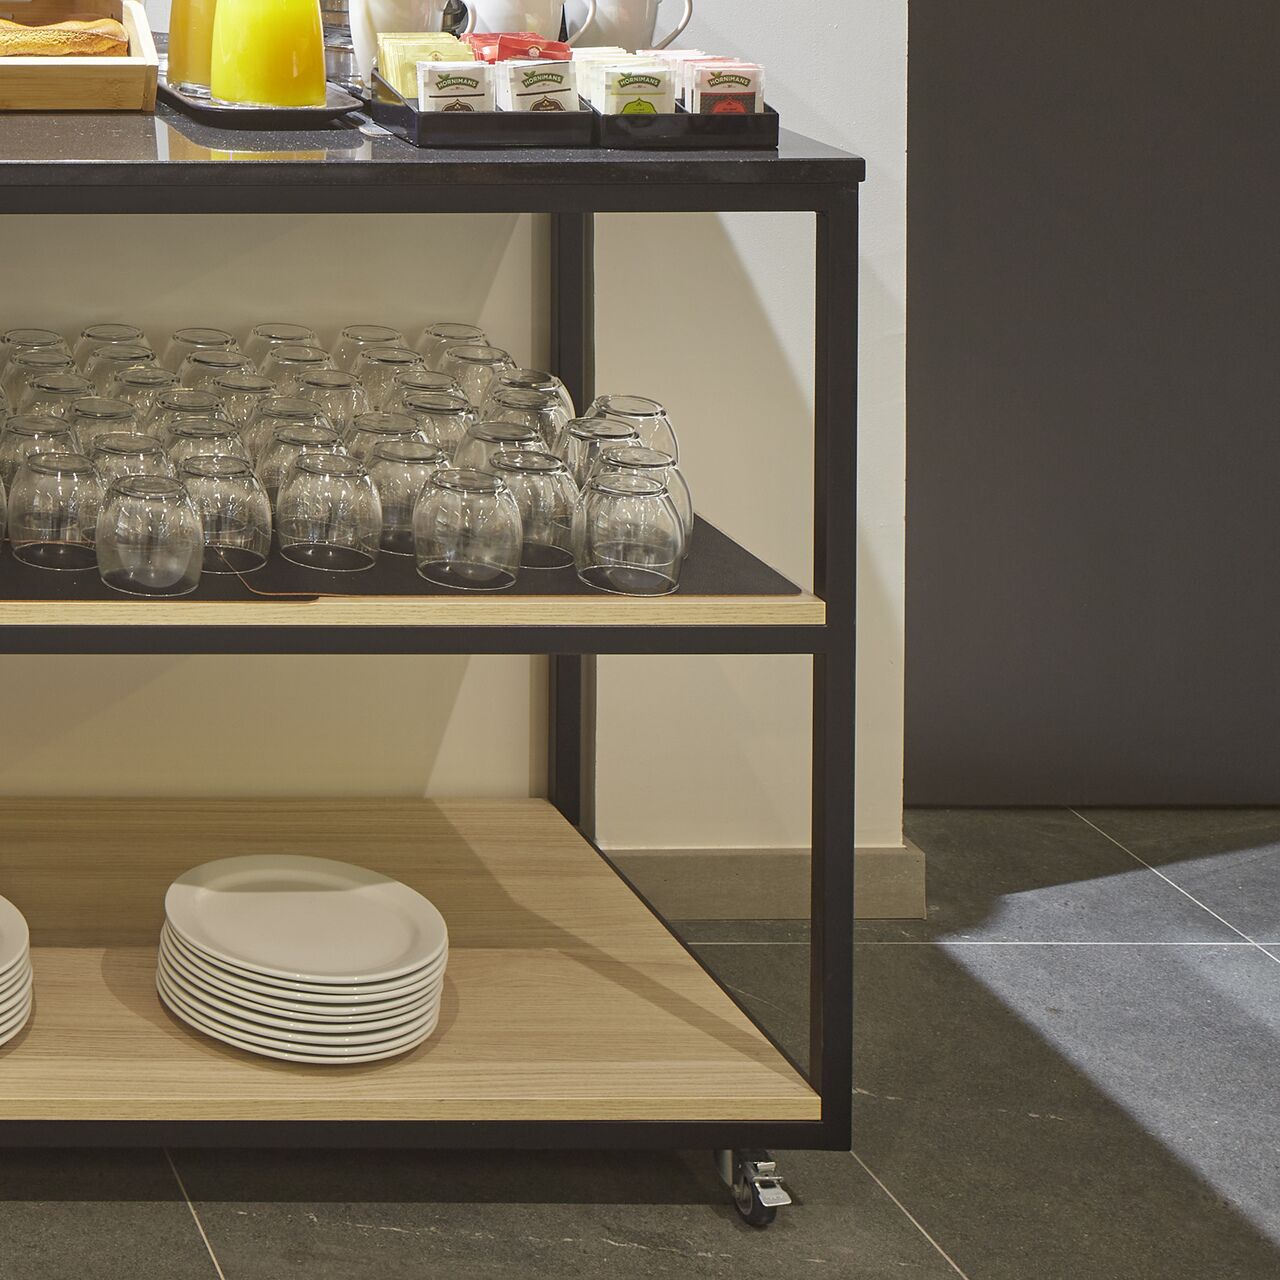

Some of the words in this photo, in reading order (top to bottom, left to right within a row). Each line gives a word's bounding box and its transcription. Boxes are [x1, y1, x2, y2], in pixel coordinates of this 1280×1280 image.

[437, 77, 477, 88] HORNIMANS
[523, 74, 561, 86] HORNIMANS
[620, 76, 658, 86] HORNIMANS
[709, 76, 749, 86] HORNIMANS
